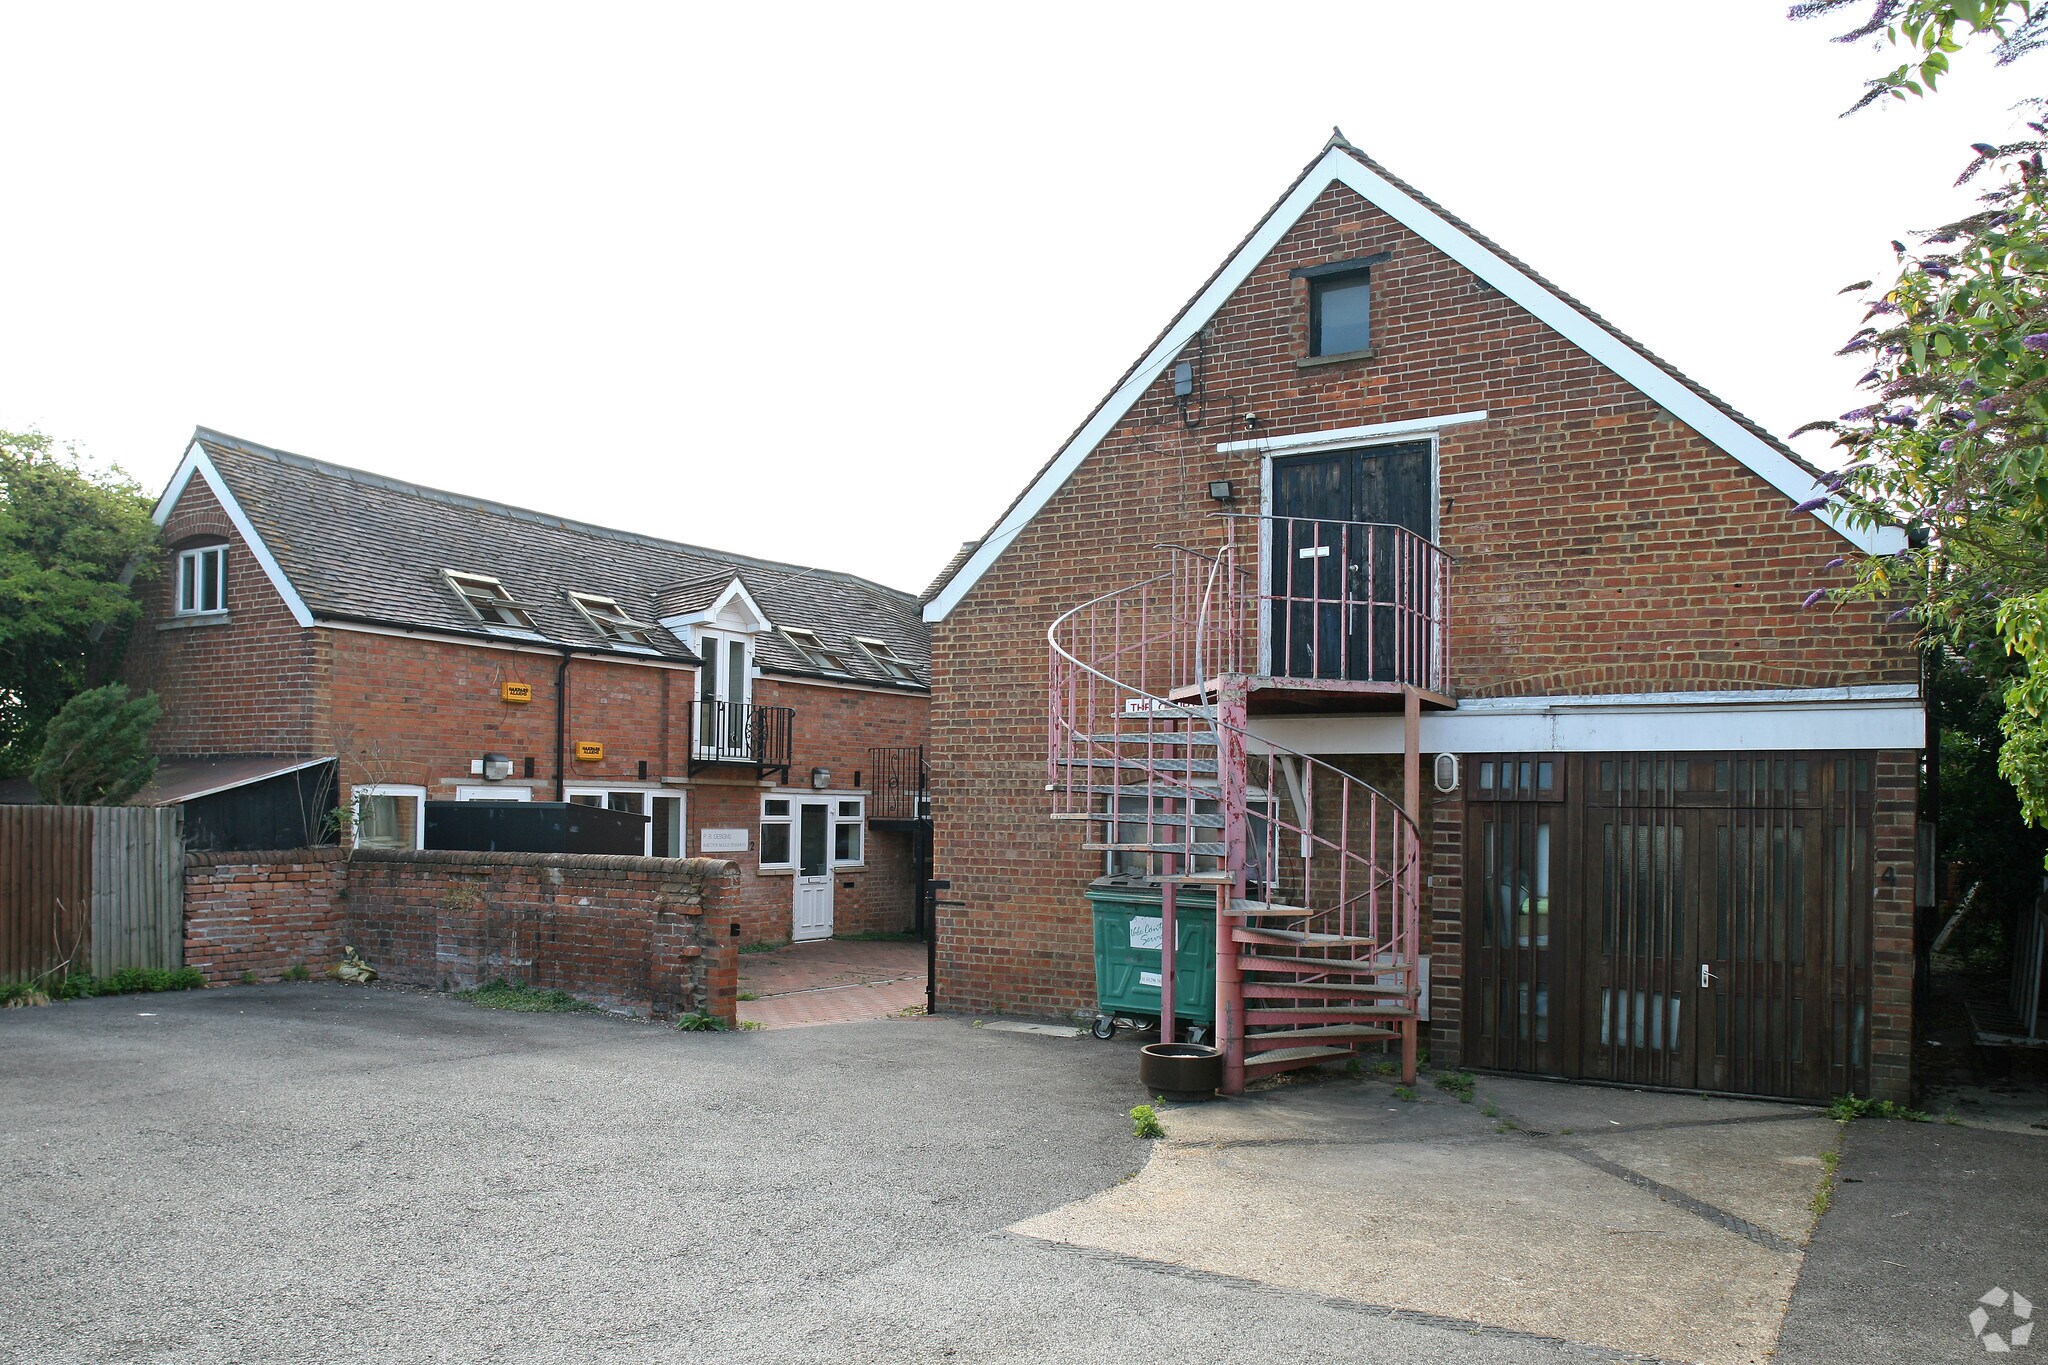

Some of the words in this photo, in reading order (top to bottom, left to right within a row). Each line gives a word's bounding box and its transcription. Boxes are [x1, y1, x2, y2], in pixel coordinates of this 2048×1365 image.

[1444, 496, 1455, 515] 7
[750, 841, 755, 851] 2
[1881, 865, 1896, 887] 4
